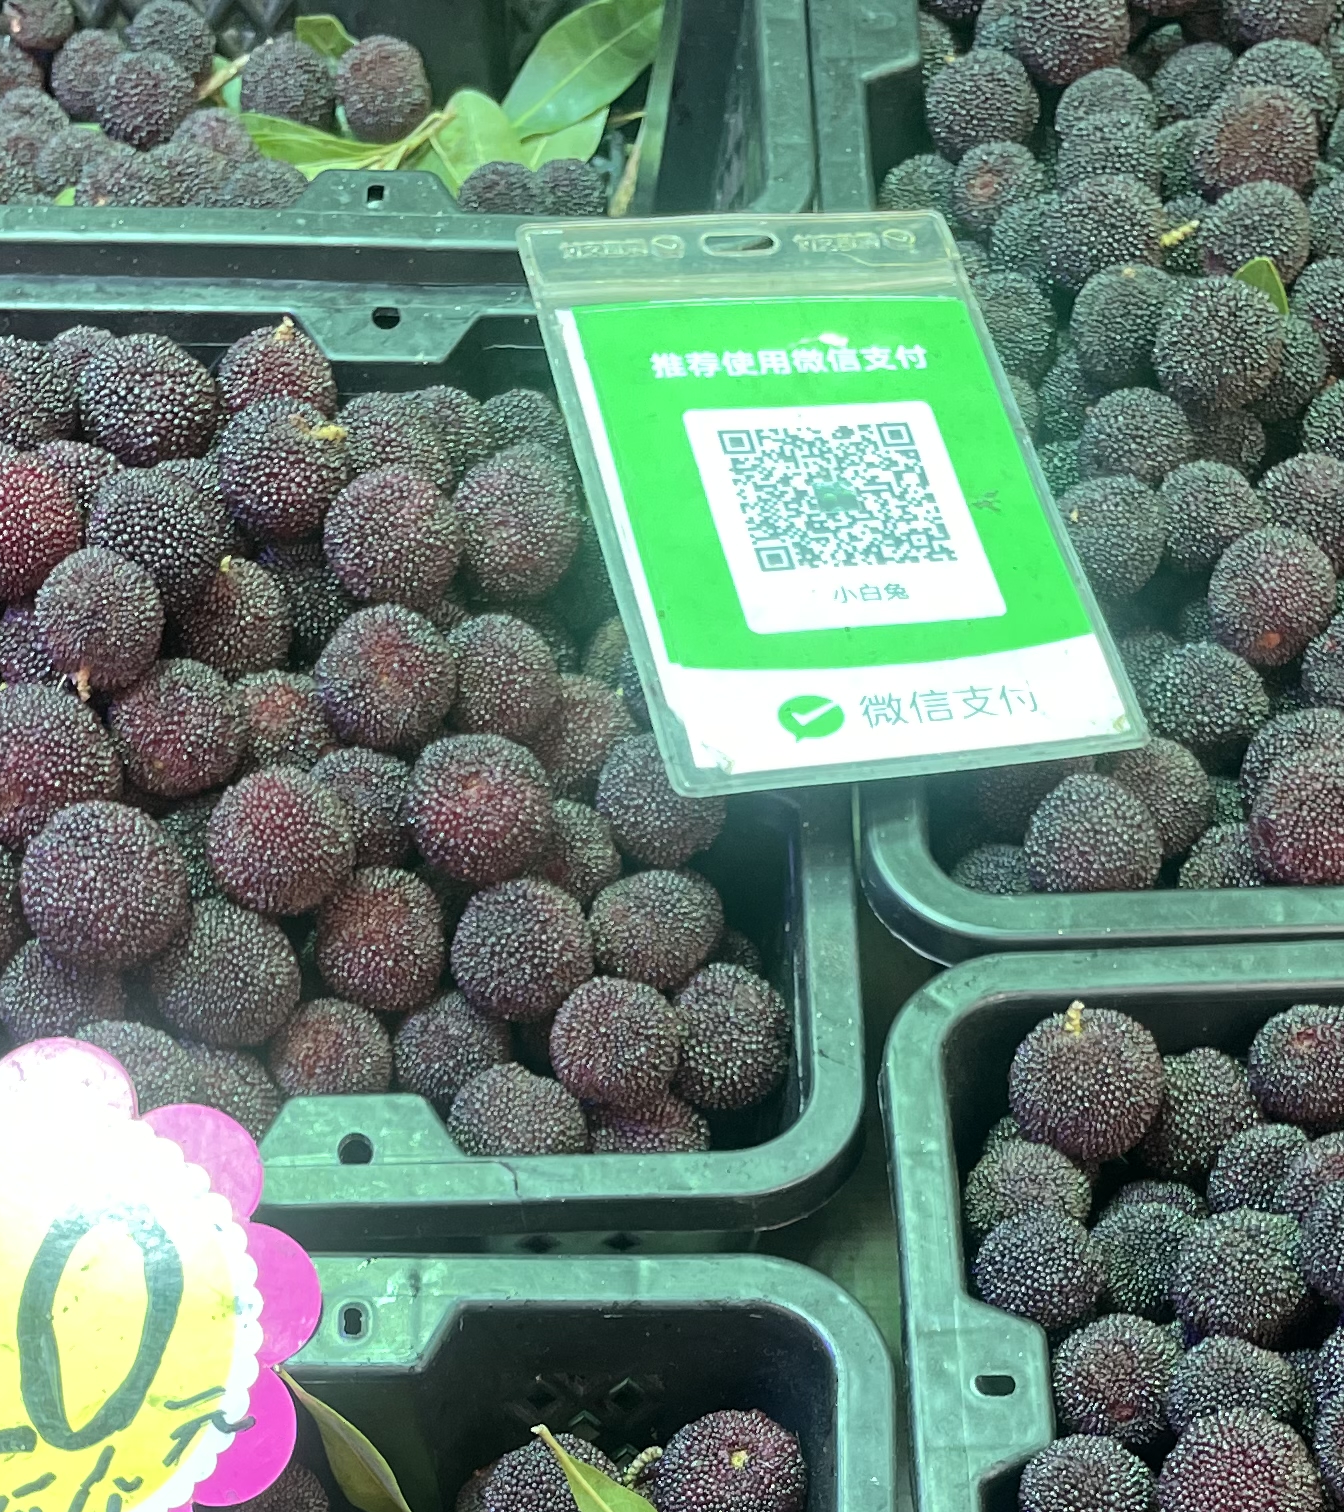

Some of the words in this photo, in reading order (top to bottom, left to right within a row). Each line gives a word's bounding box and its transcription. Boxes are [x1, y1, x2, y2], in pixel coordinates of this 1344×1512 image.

[650, 344, 928, 379] 推荐使用微信支付
[834, 583, 909, 603] 小白兔
[859, 684, 1039, 729] 微信支付
